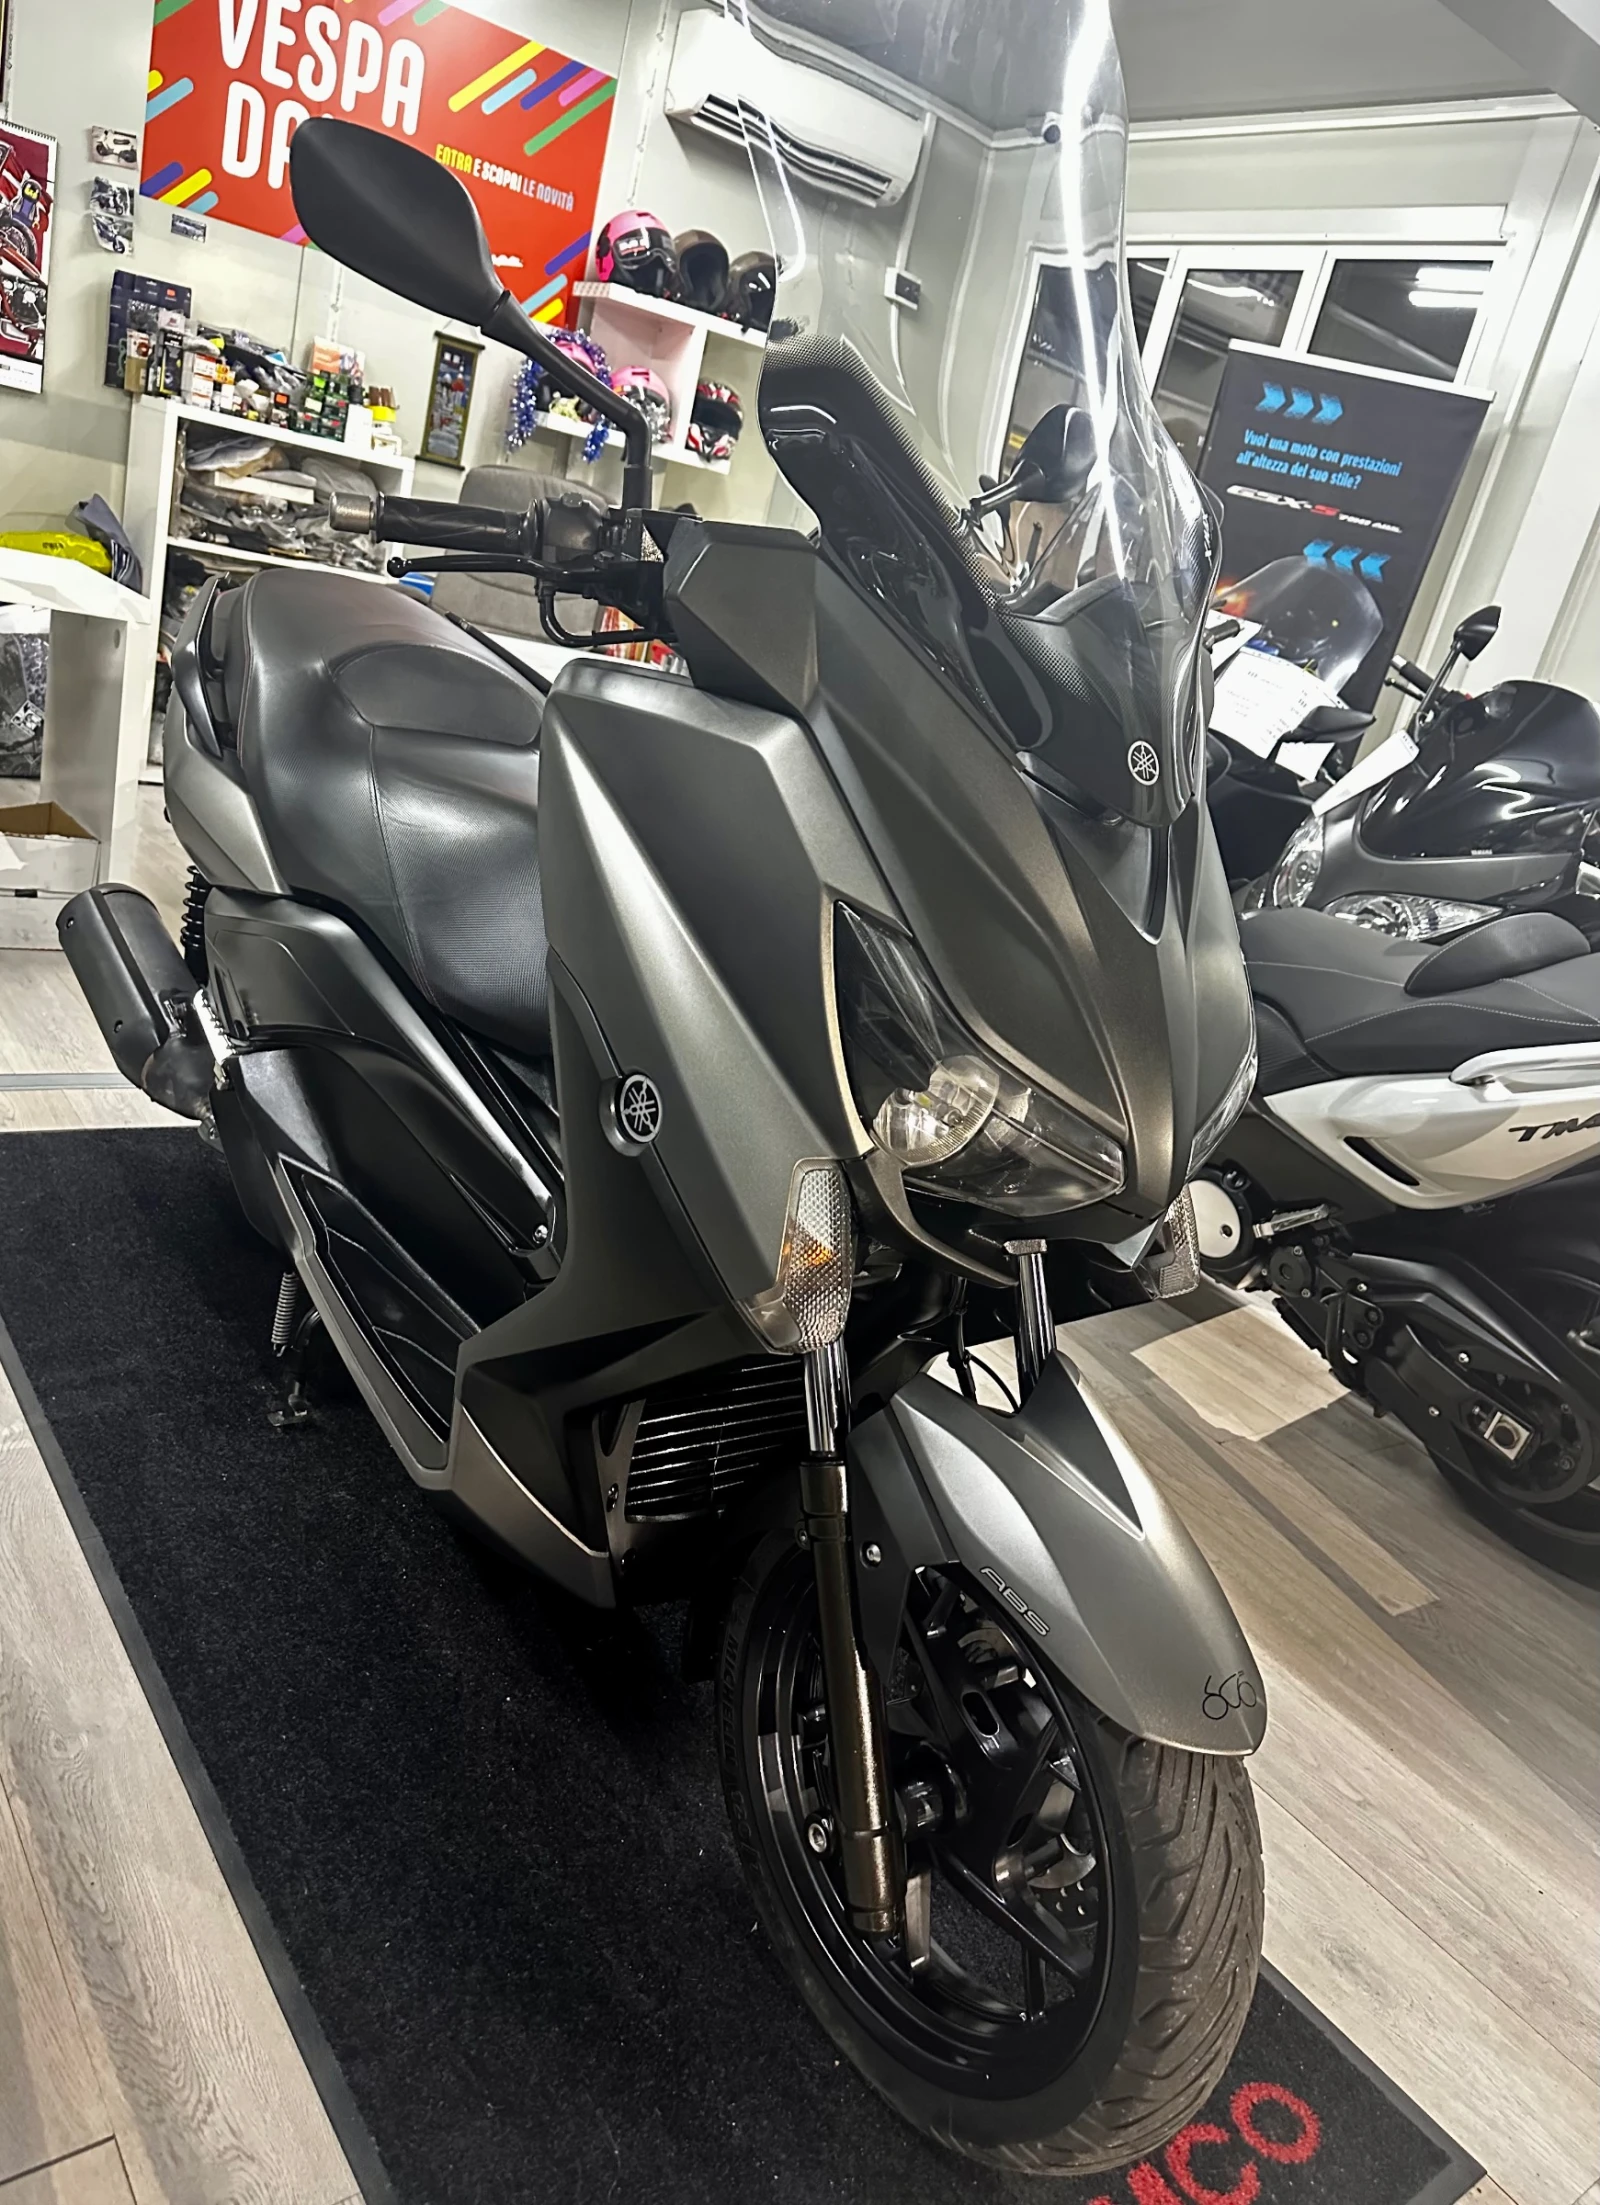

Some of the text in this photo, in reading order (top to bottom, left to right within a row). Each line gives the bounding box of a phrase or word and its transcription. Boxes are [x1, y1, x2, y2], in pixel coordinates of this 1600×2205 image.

[219, 0, 425, 135] VESPA
[222, 81, 334, 189] DA
[435, 143, 574, 212] ENTRA E SCOPRI LE NOVITÀ
[1236, 451, 1363, 490] all'altezza del suo stile?
[1244, 429, 1403, 477] Vuoi una moto con prestazioni
[979, 1565, 1050, 1637] ABS
